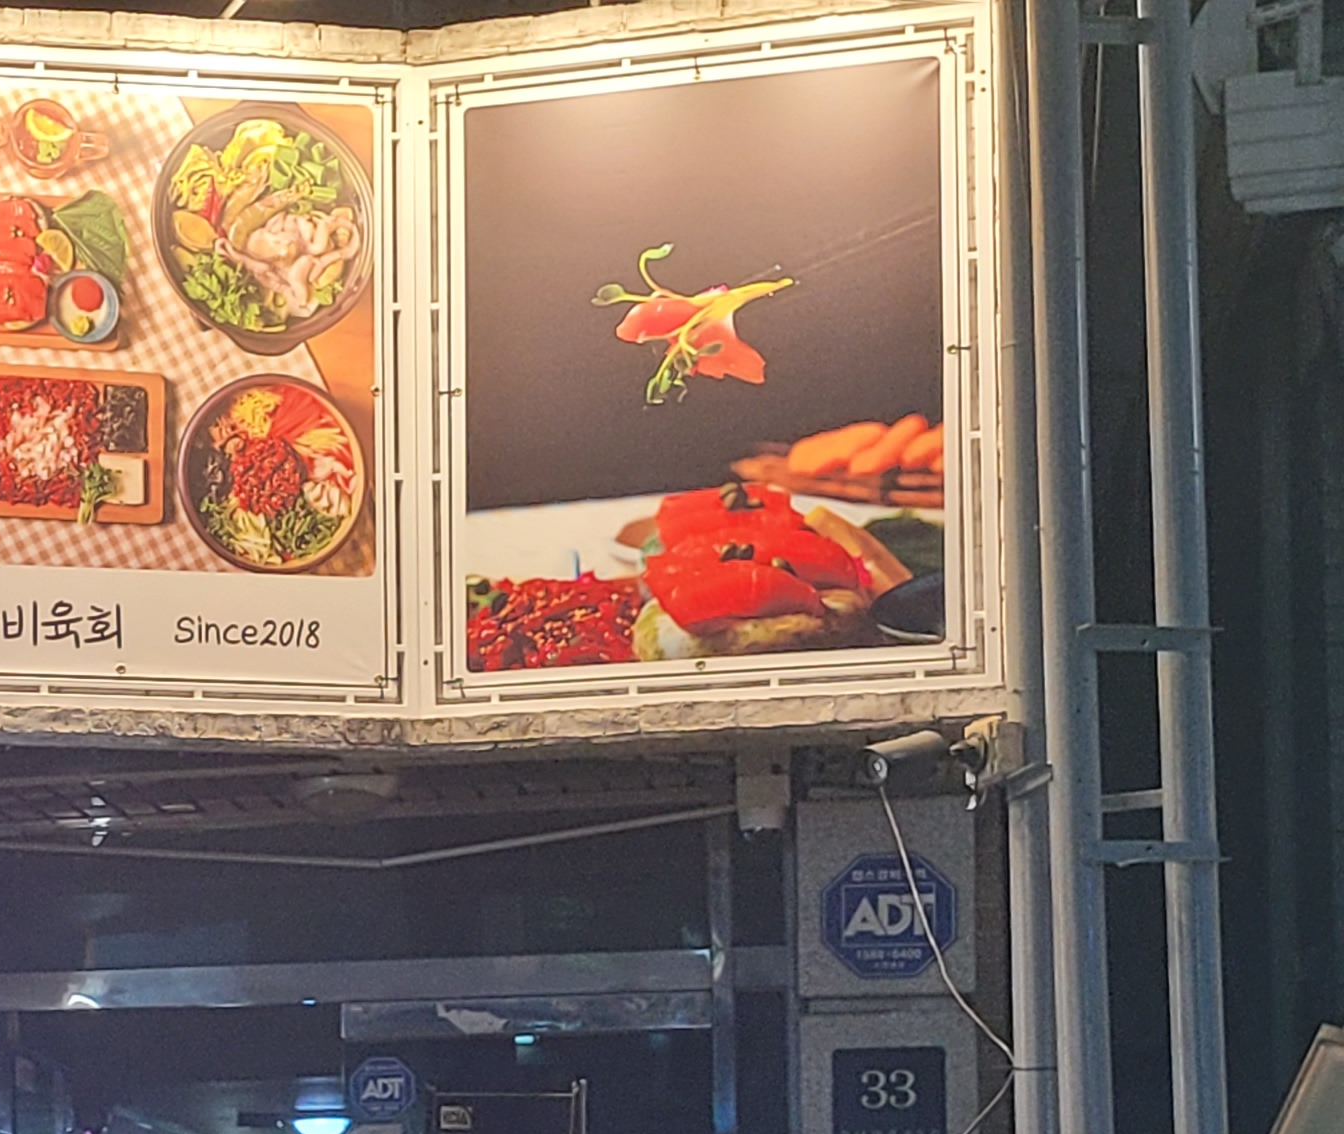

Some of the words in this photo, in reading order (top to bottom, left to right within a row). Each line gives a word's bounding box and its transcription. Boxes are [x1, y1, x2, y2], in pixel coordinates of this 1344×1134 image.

[174, 616, 321, 649] Since2018
[843, 894, 935, 936] ADT
[361, 1077, 404, 1099] ADT
[861, 1069, 917, 1110] 33
